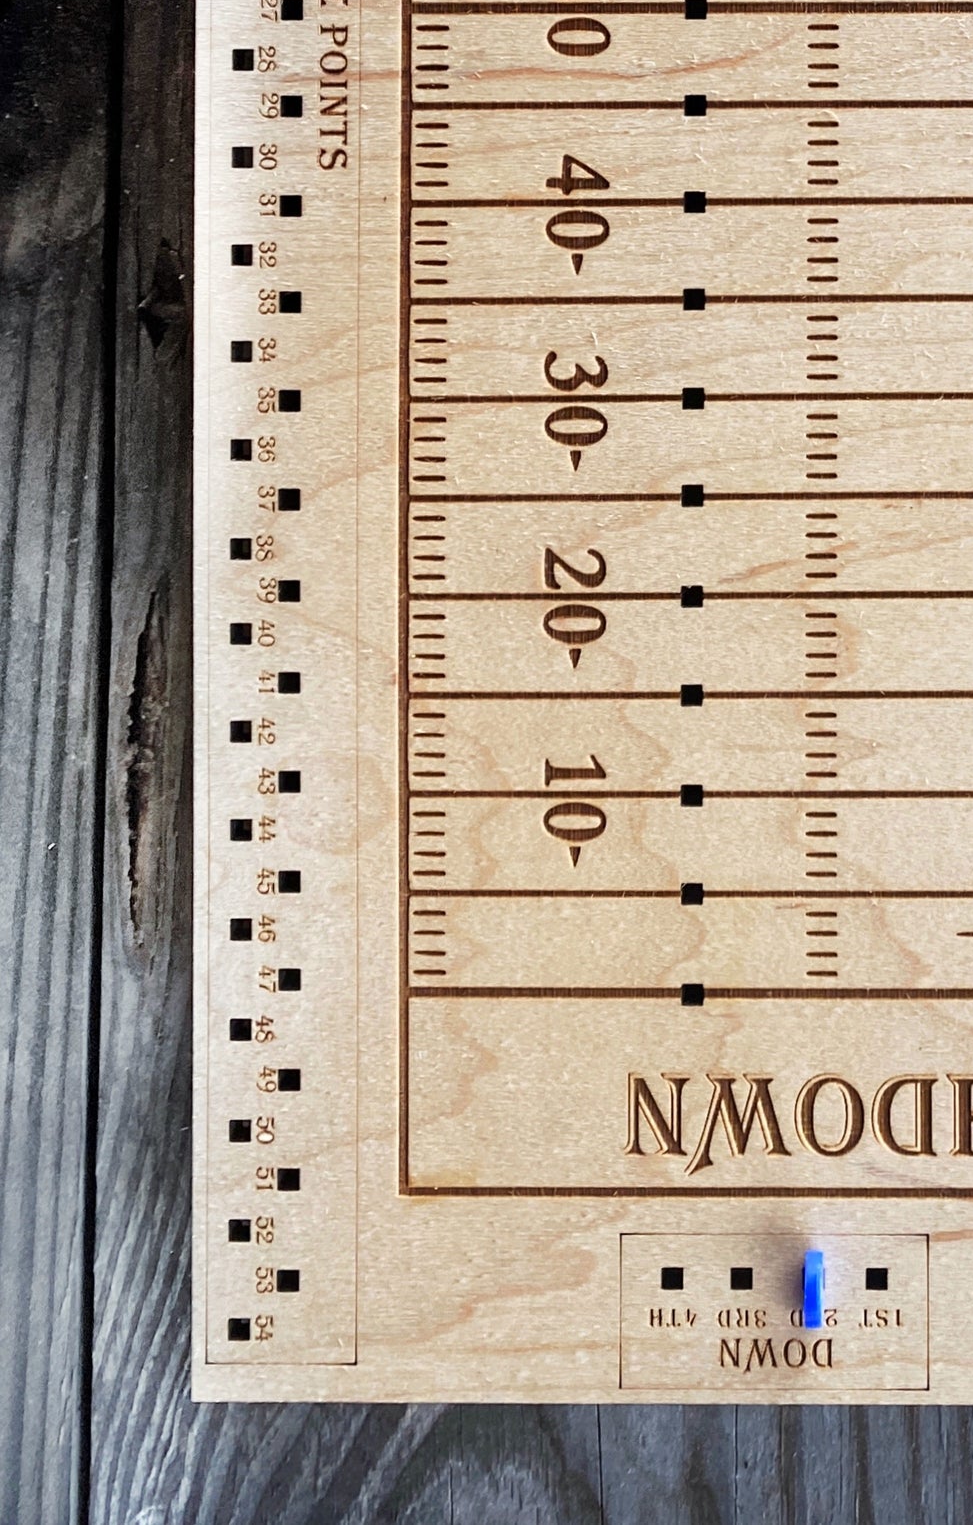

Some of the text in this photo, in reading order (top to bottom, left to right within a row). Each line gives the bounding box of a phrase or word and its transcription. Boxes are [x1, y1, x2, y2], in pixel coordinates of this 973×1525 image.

[257, 45, 278, 73] 28
[258, 92, 279, 120] 29
[317, 23, 349, 171] POINTS
[258, 142, 279, 171] 30
[258, 193, 278, 217] 31
[545, 153, 611, 251] 40
[257, 240, 278, 269] 32
[257, 288, 277, 316] 33
[257, 337, 278, 363] 34
[256, 386, 277, 414] 35
[544, 350, 610, 447] 30
[256, 435, 277, 463] 36
[257, 485, 276, 514] 37
[255, 534, 278, 563] 38
[256, 576, 277, 604] 39
[543, 544, 608, 646] 20
[257, 619, 276, 648] 40
[258, 669, 276, 694] 41
[256, 716, 277, 746] 42
[256, 766, 277, 796] 43
[542, 753, 608, 843] 10
[258, 815, 277, 844] 44
[256, 867, 276, 896] 45
[257, 913, 277, 943] 46
[258, 965, 277, 994] 47
[254, 1014, 278, 1044] 48
[255, 1065, 276, 1094] 49
[255, 1115, 276, 1146] 50
[255, 1165, 276, 1191] 51
[254, 1215, 276, 1246] 52
[254, 1266, 275, 1295] 53
[254, 1314, 275, 1343] 54
[650, 1309, 902, 1327] 1ST 2D 3RD 4TH
[719, 1338, 833, 1373] DOWN
